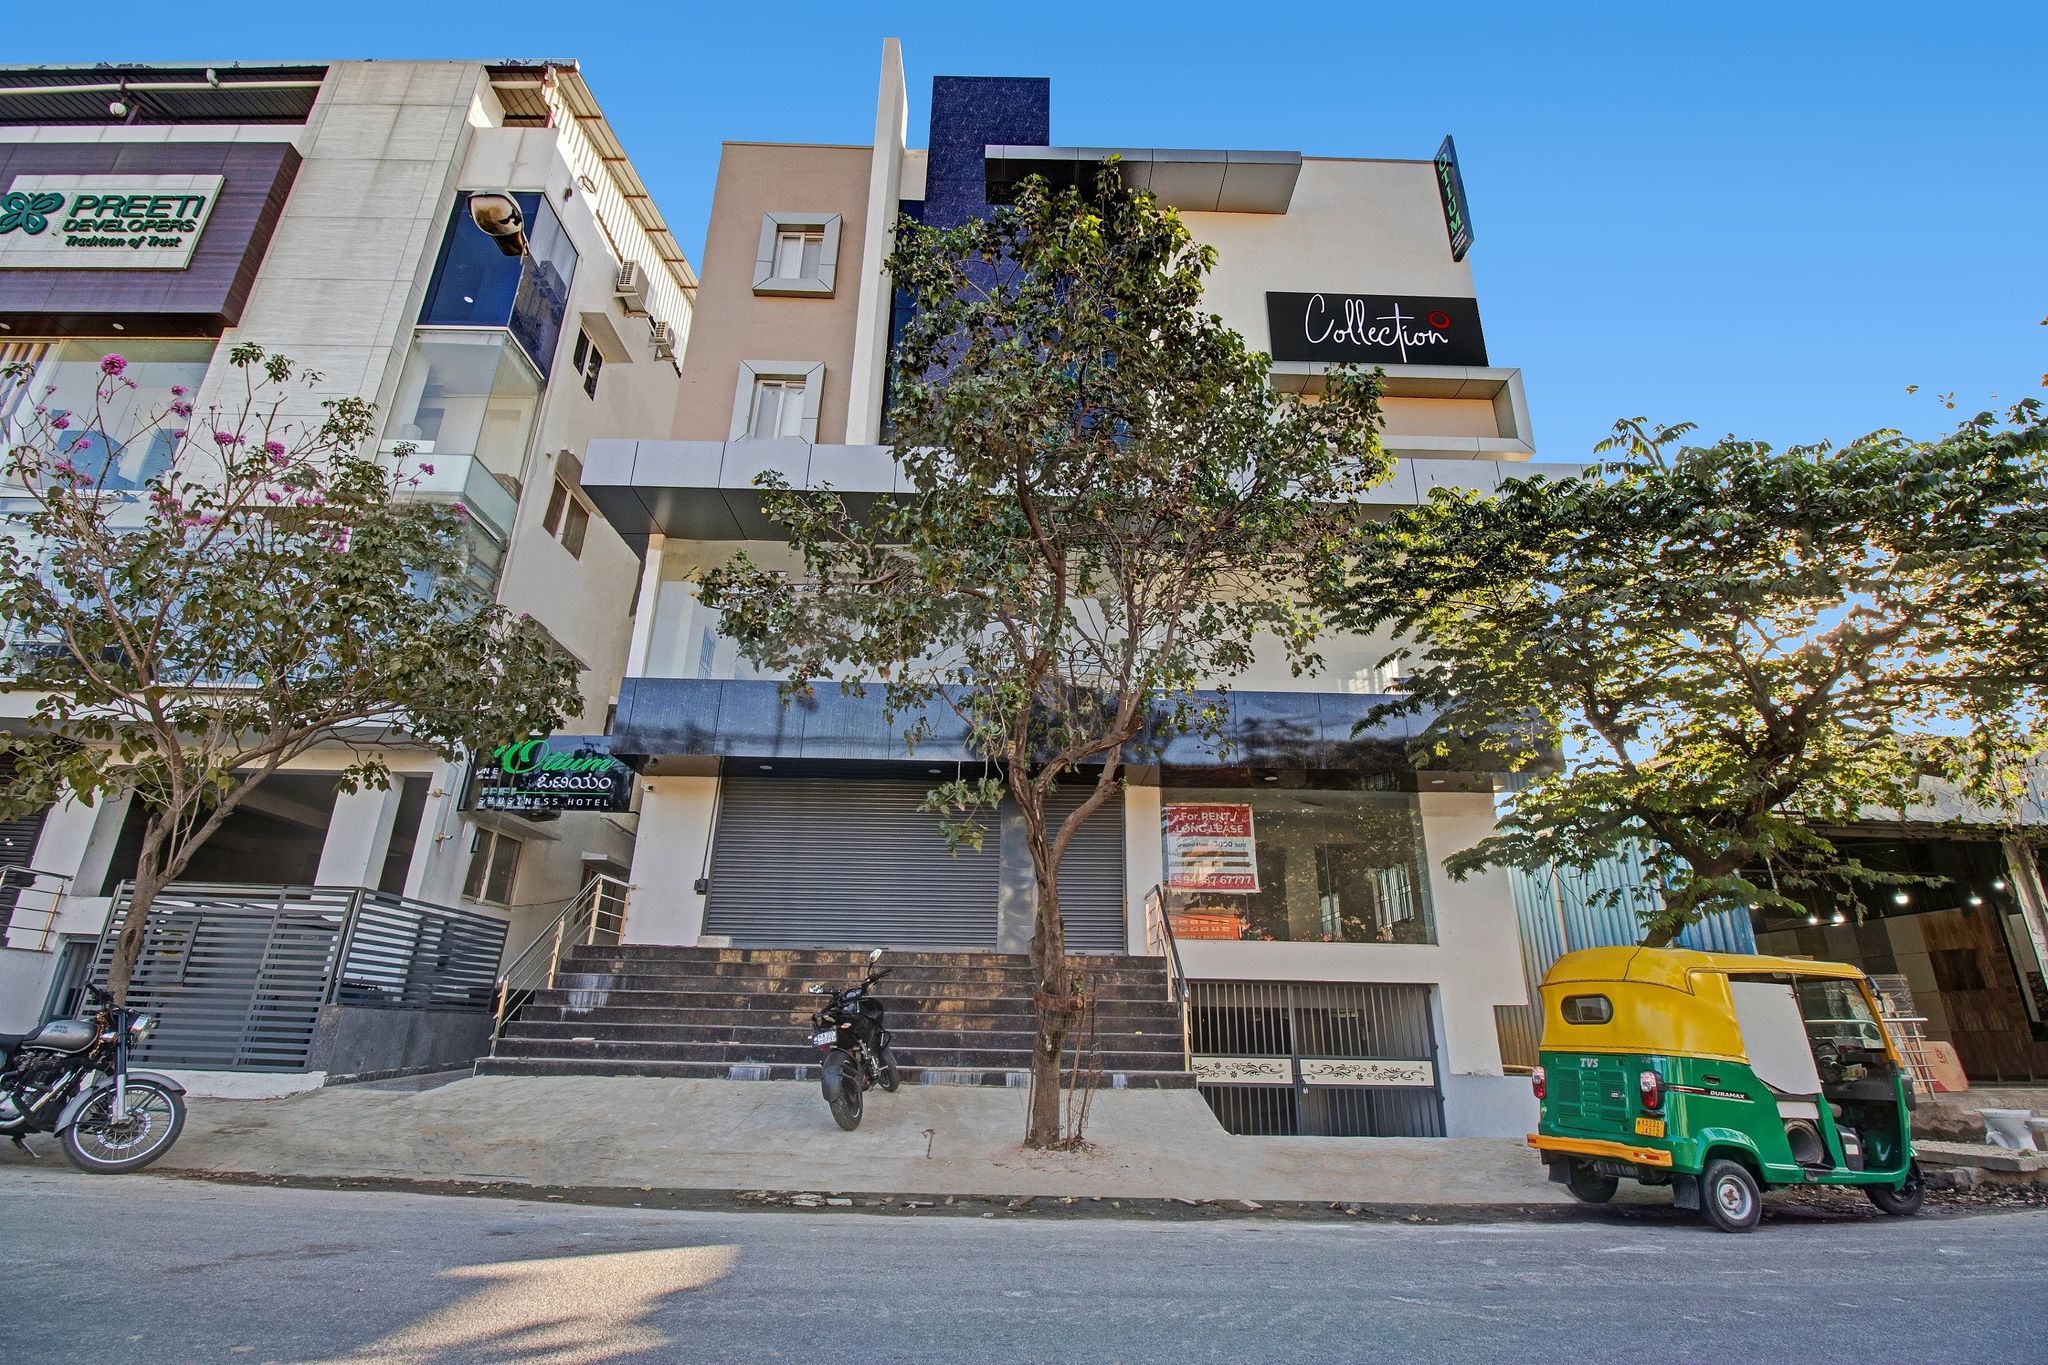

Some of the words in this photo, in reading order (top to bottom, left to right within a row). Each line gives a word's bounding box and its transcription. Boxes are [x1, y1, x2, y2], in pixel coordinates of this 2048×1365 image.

[69, 194, 207, 218] PREETI
[62, 218, 197, 233] DEVELOPERS
[65, 235, 127, 247] Tradition
[127, 235, 147, 250] of
[147, 235, 182, 247] Trust
[1305, 293, 1449, 364] Collection
[567, 797, 610, 807] HOTEL
[1181, 812, 1199, 821] For
[1201, 812, 1231, 821] RENT
[1176, 824, 1207, 833] LONG
[1210, 824, 1244, 833] LEASE
[1220, 875, 1252, 884] 67777
[1579, 1058, 1599, 1068] TVS
[1709, 1090, 1745, 1100] DURAMAX
